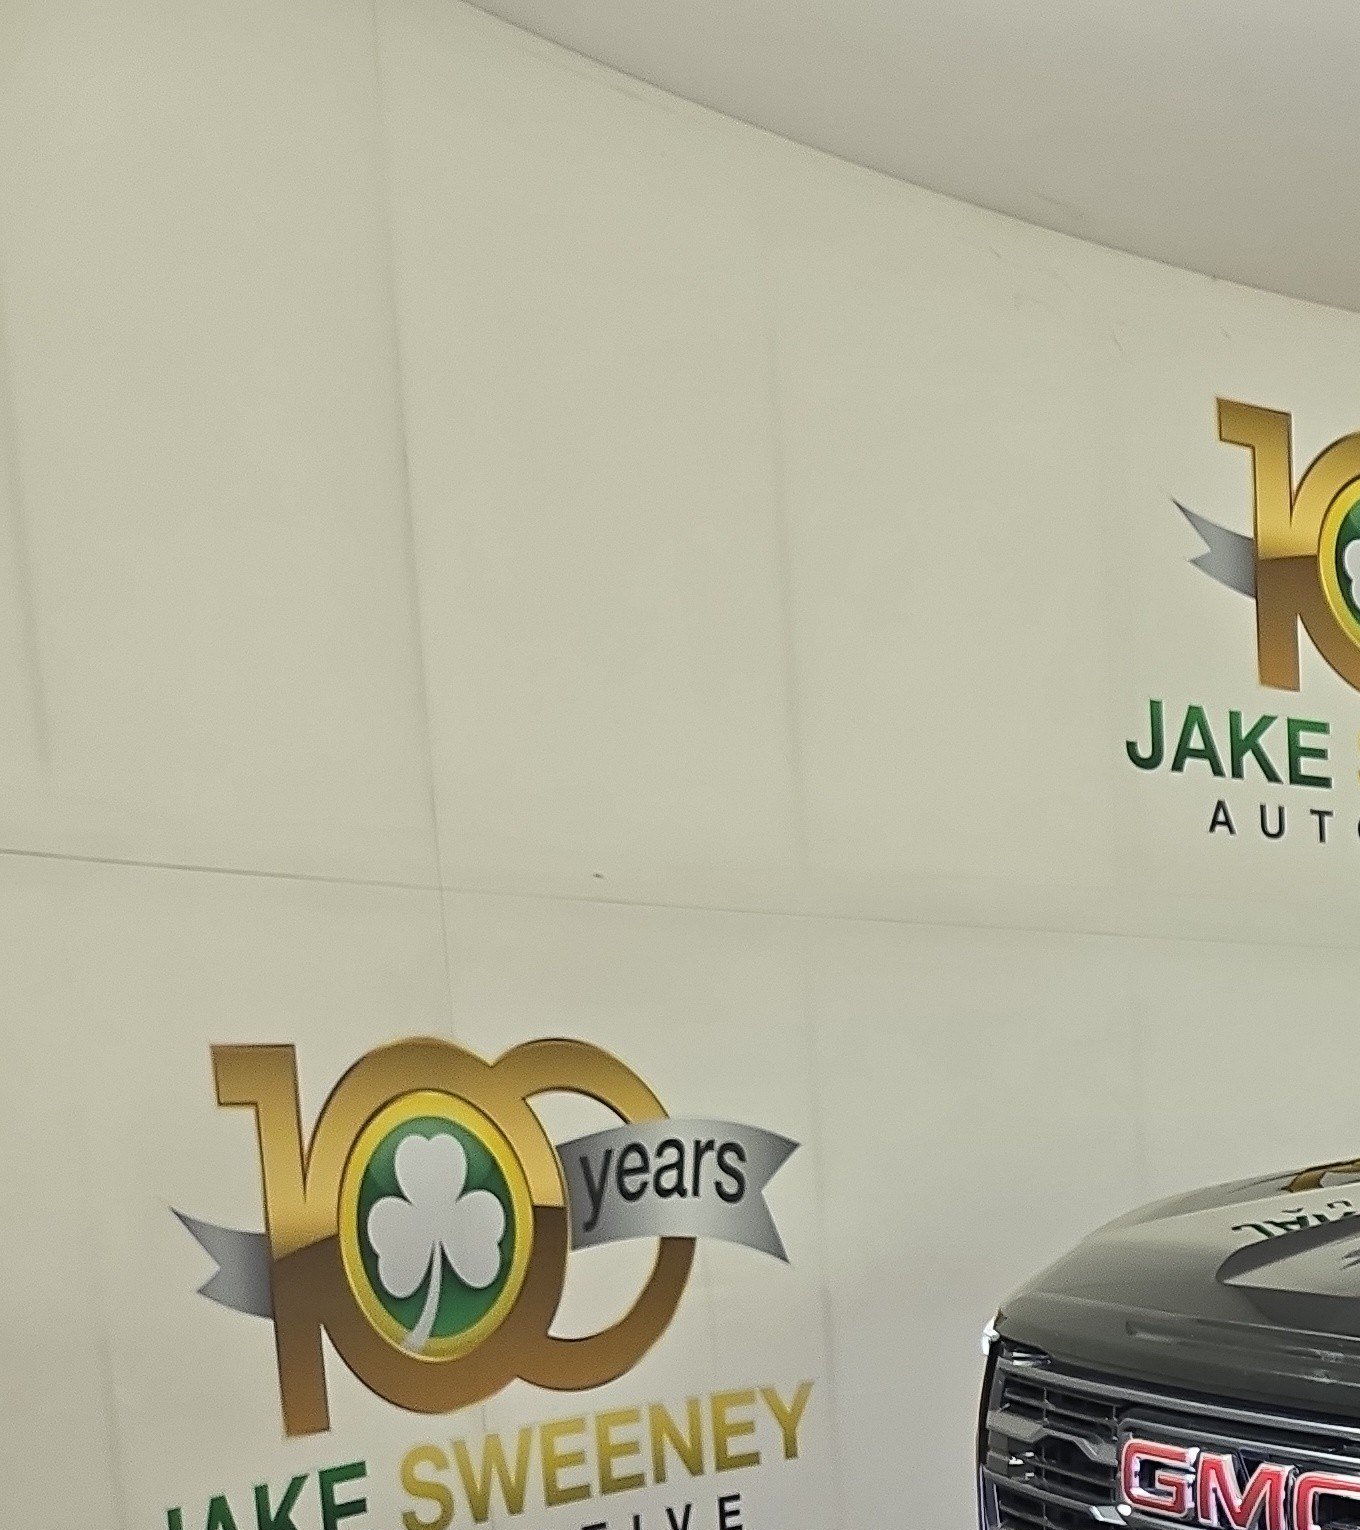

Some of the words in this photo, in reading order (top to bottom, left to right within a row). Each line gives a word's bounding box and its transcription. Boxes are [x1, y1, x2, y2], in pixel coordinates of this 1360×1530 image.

[1126, 699, 1333, 789] JAKE
[579, 1137, 748, 1233] years
[210, 1036, 697, 1438] 100
